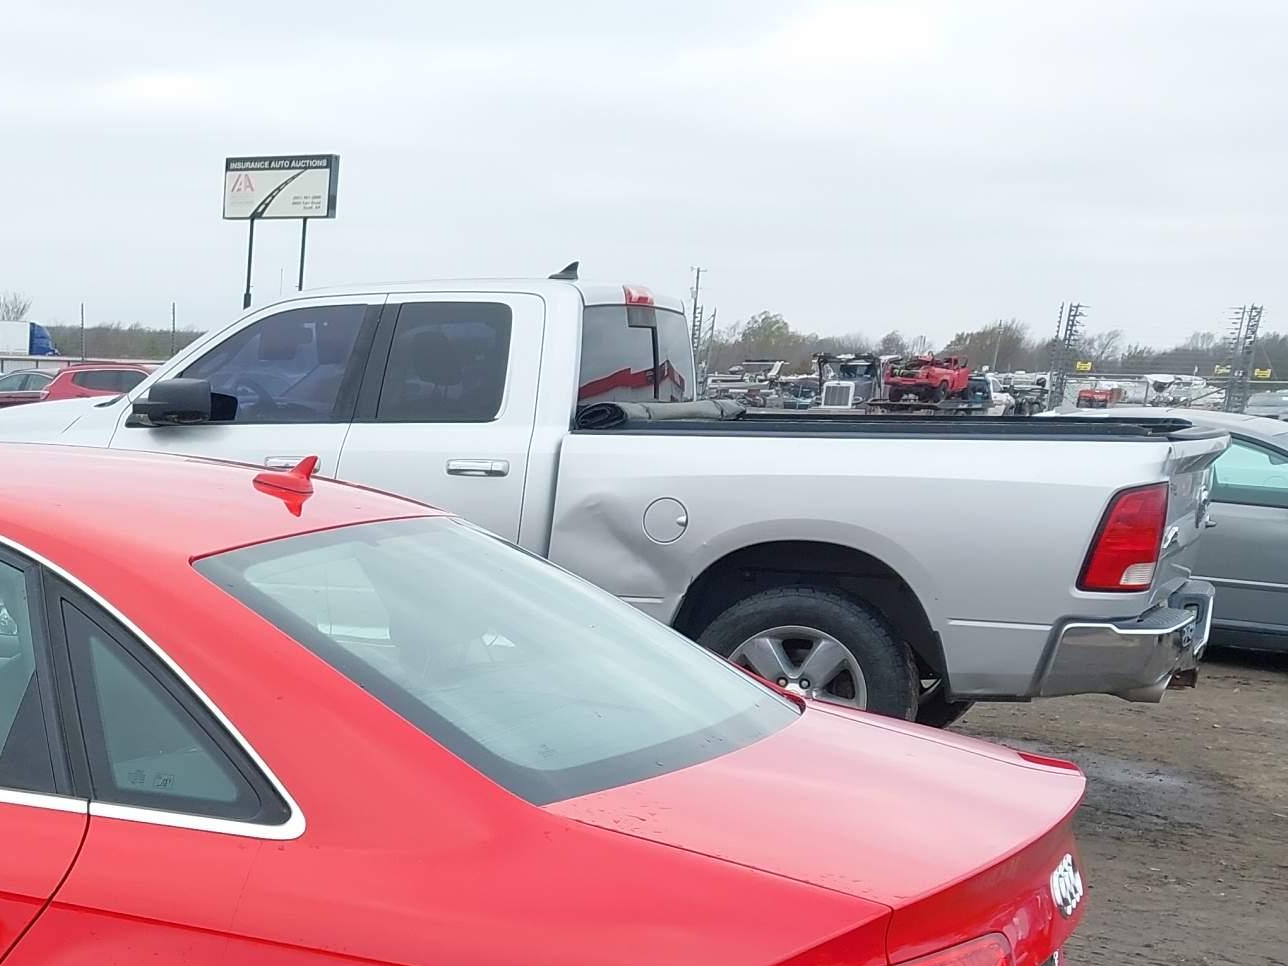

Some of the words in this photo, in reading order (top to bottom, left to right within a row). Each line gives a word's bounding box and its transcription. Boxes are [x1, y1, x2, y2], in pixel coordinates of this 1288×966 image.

[229, 160, 270, 169] INSURANCE
[270, 159, 290, 169] AUTO
[290, 158, 328, 168] AUCTIONS
